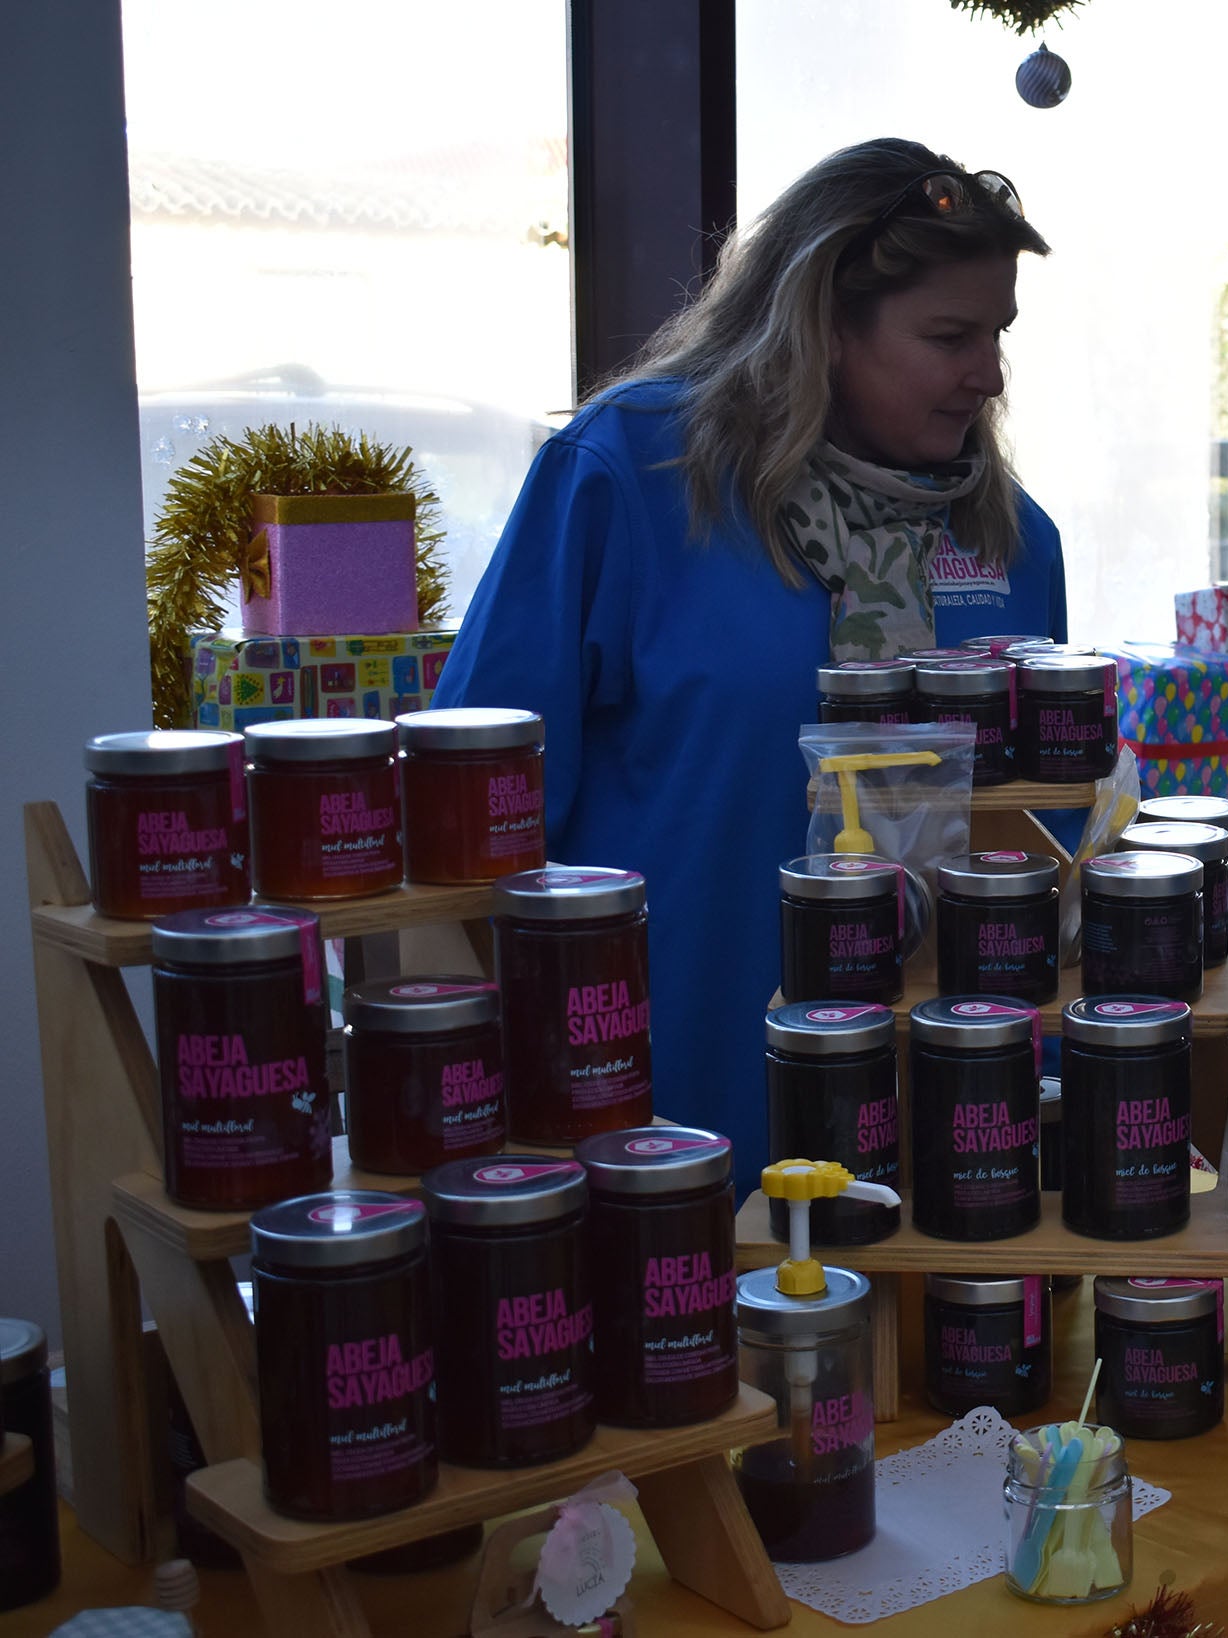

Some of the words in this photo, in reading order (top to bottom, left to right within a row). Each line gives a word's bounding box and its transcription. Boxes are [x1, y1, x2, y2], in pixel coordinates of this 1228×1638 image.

[1040, 709, 1074, 726] ABEJA
[1040, 723, 1103, 742] SAYAGUESA
[488, 774, 528, 797] ABEJA
[320, 792, 367, 815] ABEJA
[137, 810, 189, 833] ABEJA
[137, 827, 229, 856] SAYAGUESA
[829, 924, 869, 941] ABEJA
[978, 923, 1017, 941] ABEJA
[829, 935, 895, 958] SAYAGUESA
[978, 935, 1046, 957] SAYAGUESA
[567, 979, 631, 1017] ABEJA
[177, 1033, 249, 1067] ABEJA
[177, 1055, 310, 1100] SAYAGUESA
[441, 1059, 485, 1087] ABEJA
[952, 1099, 1011, 1129] ABEJA
[1116, 1096, 1171, 1125] ABEJA
[952, 1169, 975, 1181] miel
[976, 1167, 989, 1180] de
[990, 1166, 1020, 1180] bosque
[1115, 1166, 1137, 1177] miel
[1138, 1164, 1151, 1177] de
[644, 1251, 713, 1287] ABEJA
[496, 1287, 568, 1329] ABEJA
[942, 1326, 978, 1346] ABEJA
[326, 1333, 403, 1377] ABEJA
[942, 1343, 1013, 1363] SAYAGUESA
[1125, 1347, 1165, 1368] ABEJA
[1124, 1361, 1199, 1384] SAYAGUESA
